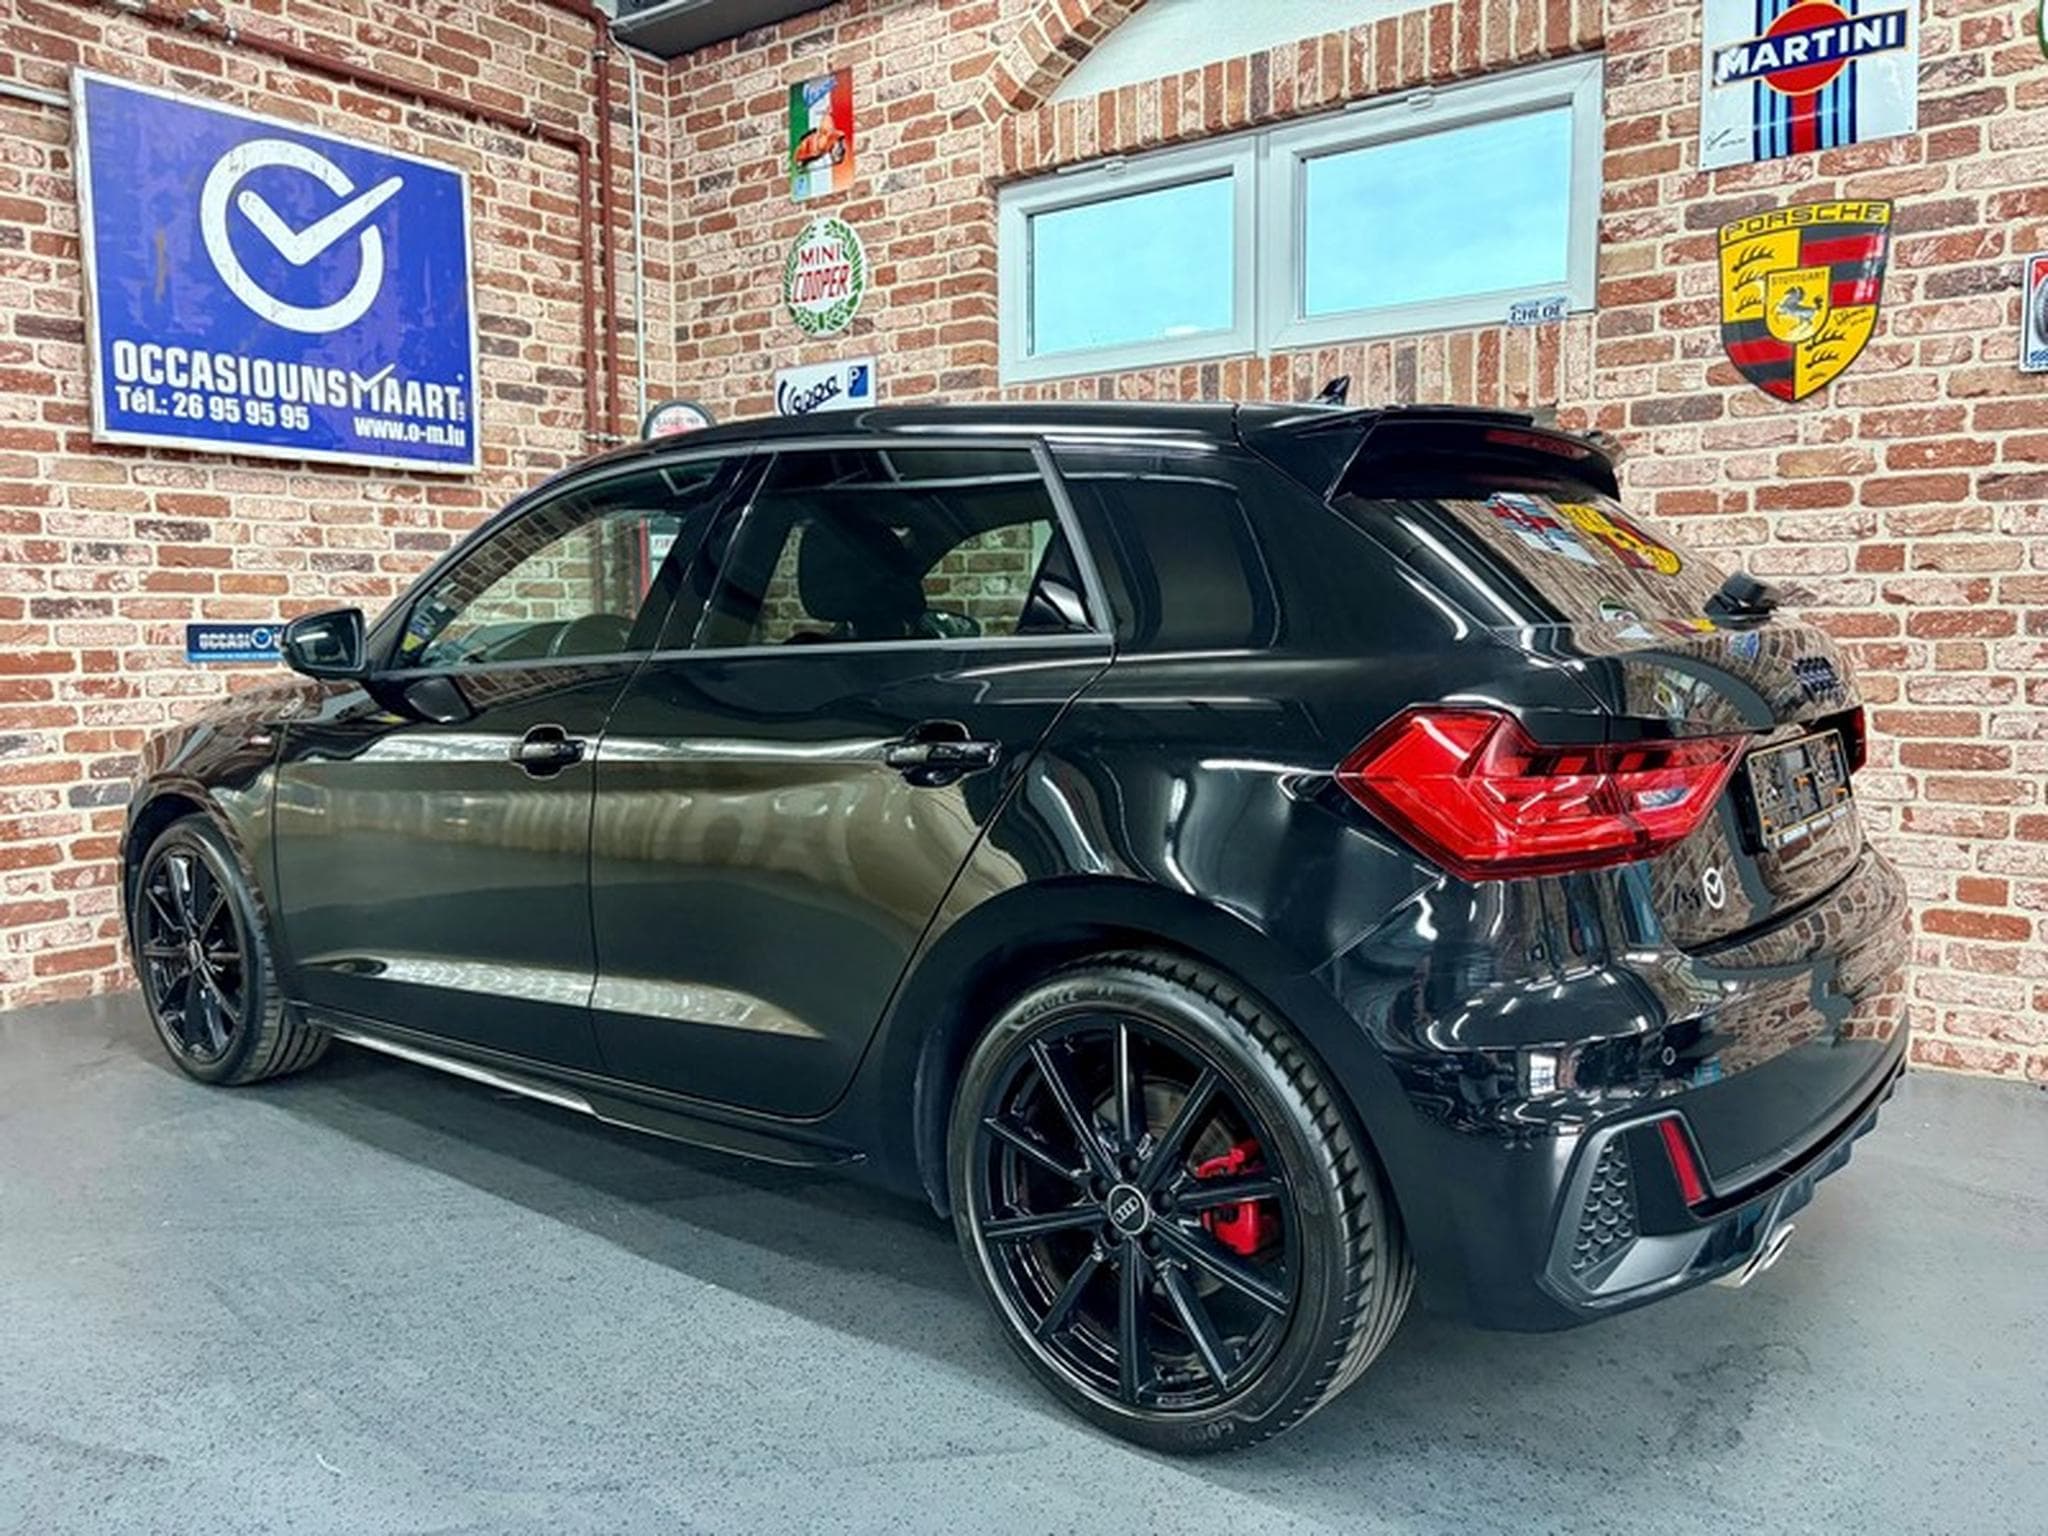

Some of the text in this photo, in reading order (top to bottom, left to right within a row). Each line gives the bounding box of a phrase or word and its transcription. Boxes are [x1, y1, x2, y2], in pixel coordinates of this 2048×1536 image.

[1719, 15, 1898, 80] MARTINI
[1725, 203, 1886, 241] PORSCHE
[800, 242, 841, 268] MINI
[793, 264, 850, 303] COOPER
[172, 391, 205, 420] 26
[208, 395, 241, 424] 95
[245, 399, 277, 428] 95
[280, 403, 311, 432] 95
[353, 415, 466, 448] www.o-m.lu
